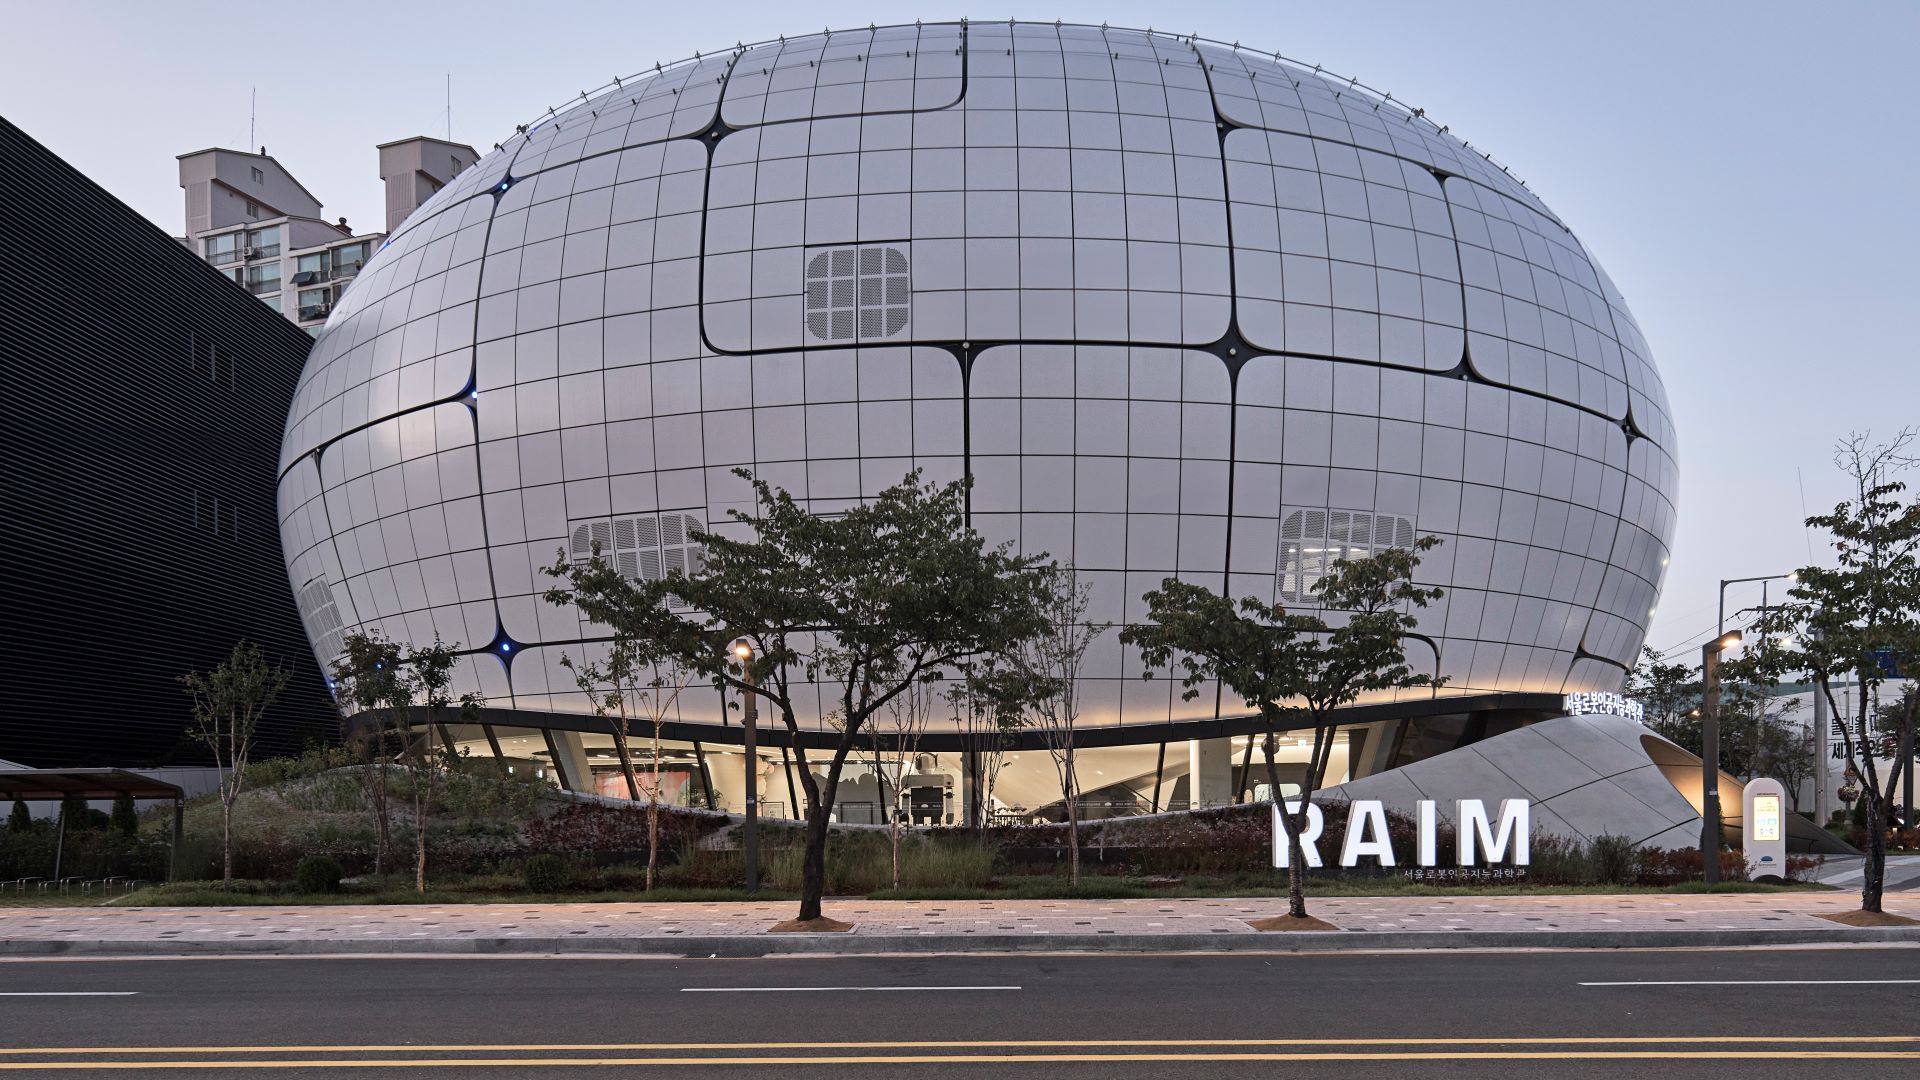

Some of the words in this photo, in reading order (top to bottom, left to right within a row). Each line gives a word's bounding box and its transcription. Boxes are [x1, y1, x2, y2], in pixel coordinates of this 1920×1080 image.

[1566, 691, 1644, 724] 서울로봇인공지능과학관
[1272, 799, 1530, 868] RAIM
[1403, 868, 1527, 880] 서울로봇인공지능과학관
